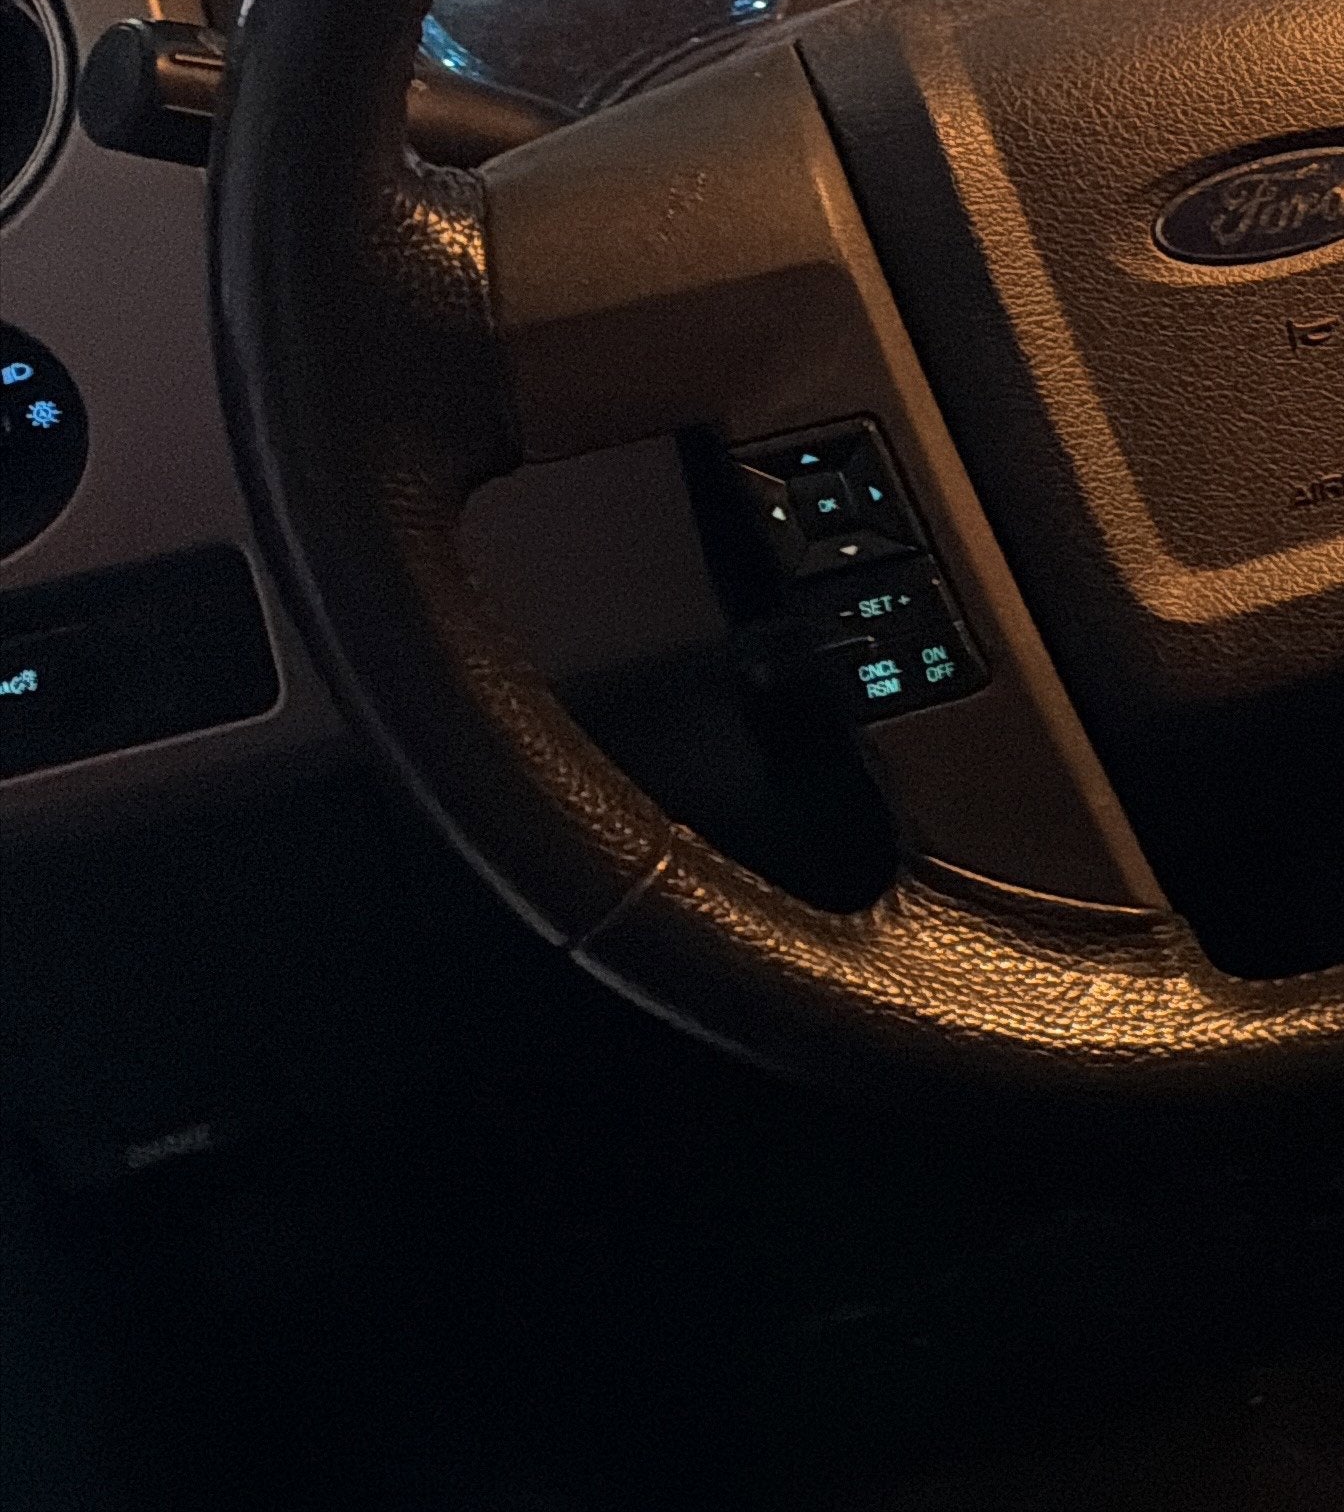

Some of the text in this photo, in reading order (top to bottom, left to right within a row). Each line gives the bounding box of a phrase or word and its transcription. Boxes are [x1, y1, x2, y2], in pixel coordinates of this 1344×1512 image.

[817, 498, 838, 513] OK
[858, 595, 893, 618] SET
[921, 646, 949, 664] ON
[858, 659, 902, 682] CNCL
[926, 662, 955, 683] OFF
[867, 678, 902, 699] RSM
